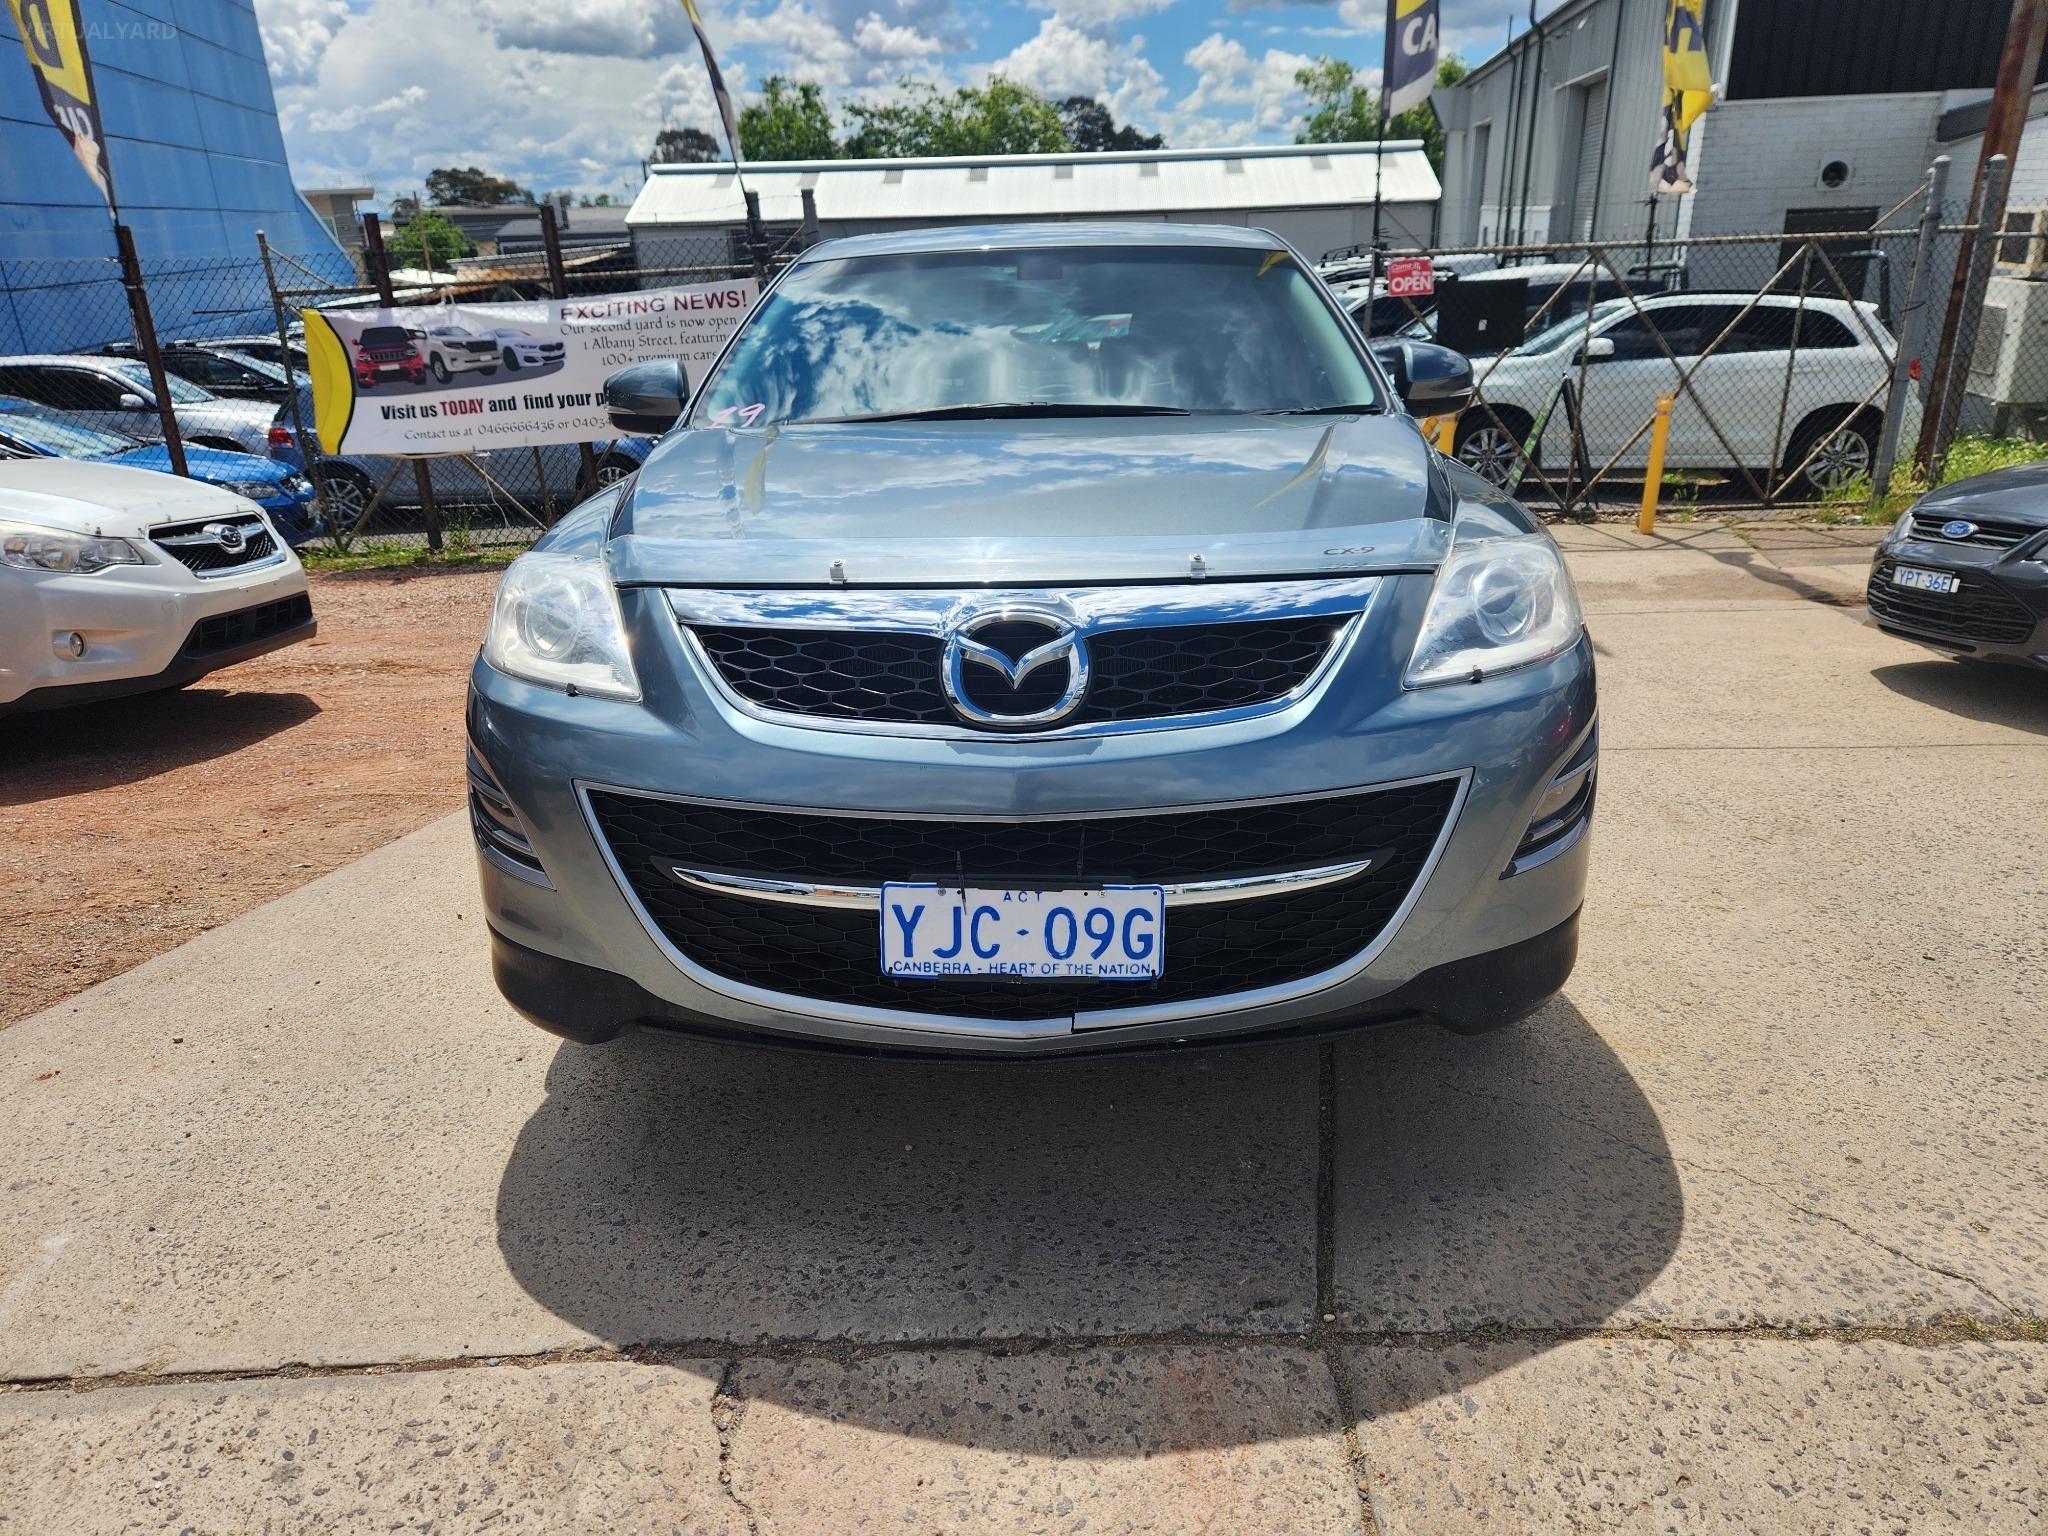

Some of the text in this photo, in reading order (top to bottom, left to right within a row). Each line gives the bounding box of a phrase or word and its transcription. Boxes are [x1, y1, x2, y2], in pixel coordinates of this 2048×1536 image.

[1391, 275, 1432, 292] OPEN
[561, 290, 747, 320] EXCITING NEWS!
[561, 314, 737, 336] Our second yard is now open
[592, 336, 635, 351] Albany
[681, 331, 730, 345] featurin
[602, 353, 633, 366] 100+
[694, 351, 717, 361] cars
[381, 404, 417, 420] Visit
[420, 405, 438, 418] us
[440, 398, 484, 416] TODAY
[489, 396, 517, 412] and
[523, 393, 555, 410] find
[557, 392, 591, 409] your
[404, 429, 446, 440] Contact
[449, 430, 461, 438] us
[463, 427, 472, 436] at
[478, 418, 555, 435] 0466666436
[558, 421, 569, 429] or
[1323, 546, 1375, 556] CX-9
[1003, 891, 1042, 903] ACT
[893, 961, 971, 974] CANBERRA
[989, 963, 1036, 975] HEART
[1041, 964, 1060, 975] OF
[1066, 964, 1093, 975] THE
[1099, 964, 1152, 975] NATION
